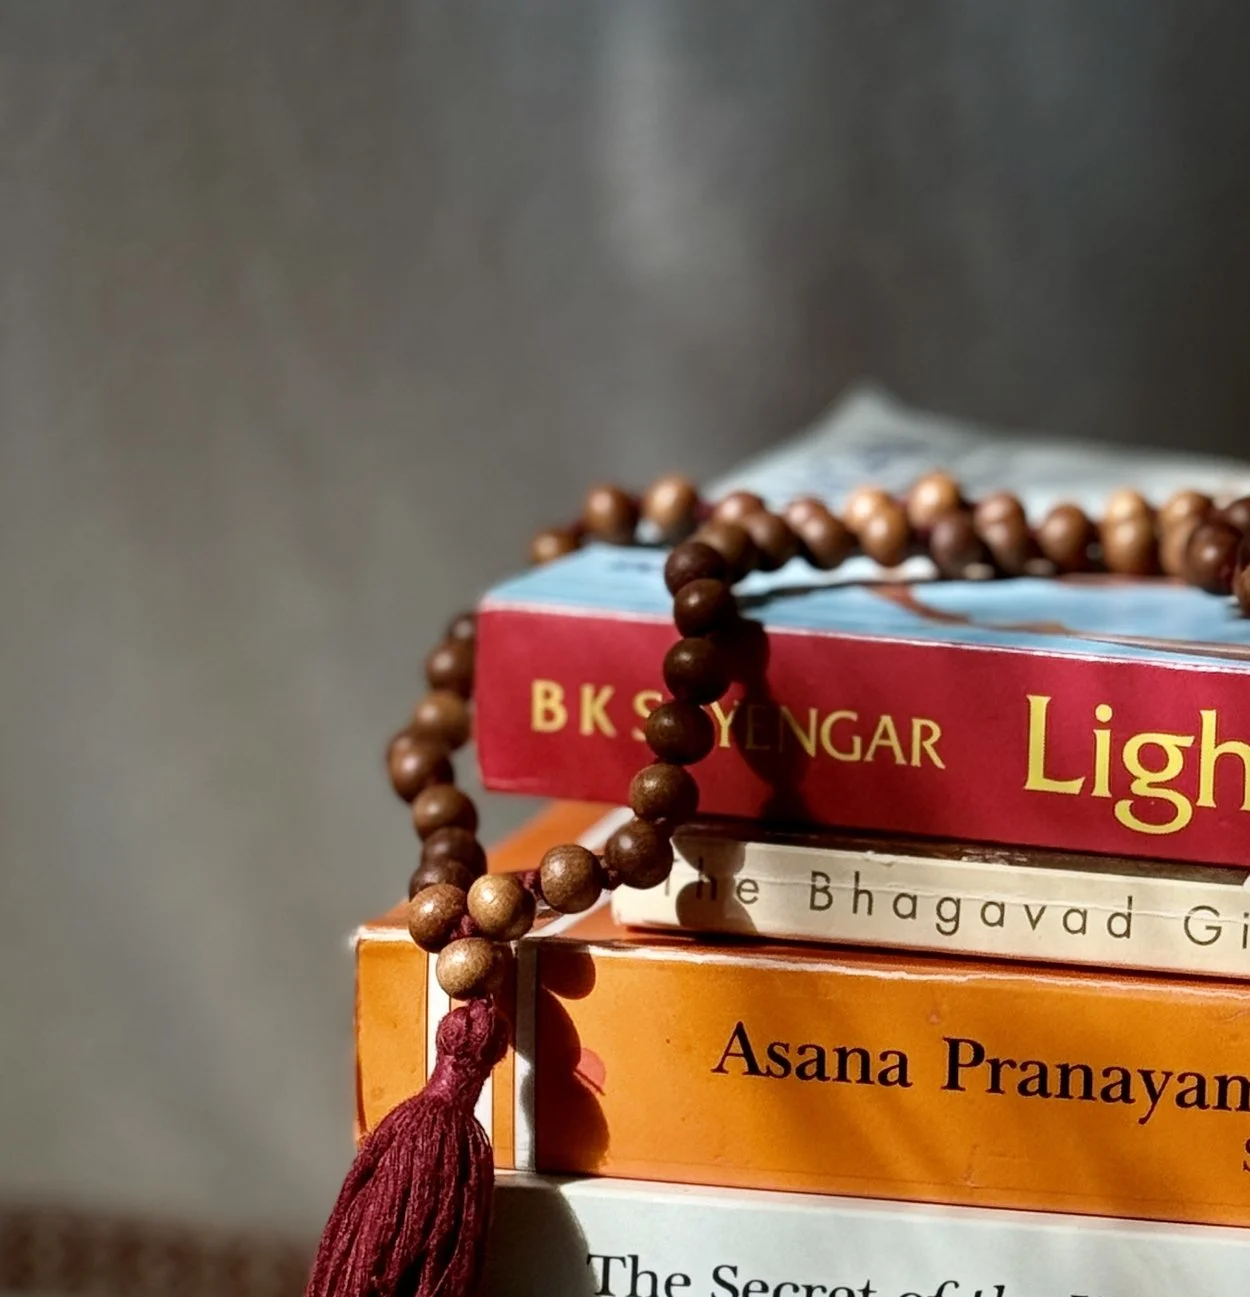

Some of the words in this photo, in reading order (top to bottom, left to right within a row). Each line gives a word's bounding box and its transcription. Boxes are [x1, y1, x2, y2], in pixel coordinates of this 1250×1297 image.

[699, 699, 946, 769] YENGAR
[808, 869, 1135, 940] Bhagavad
[710, 1020, 913, 1088] Asana
